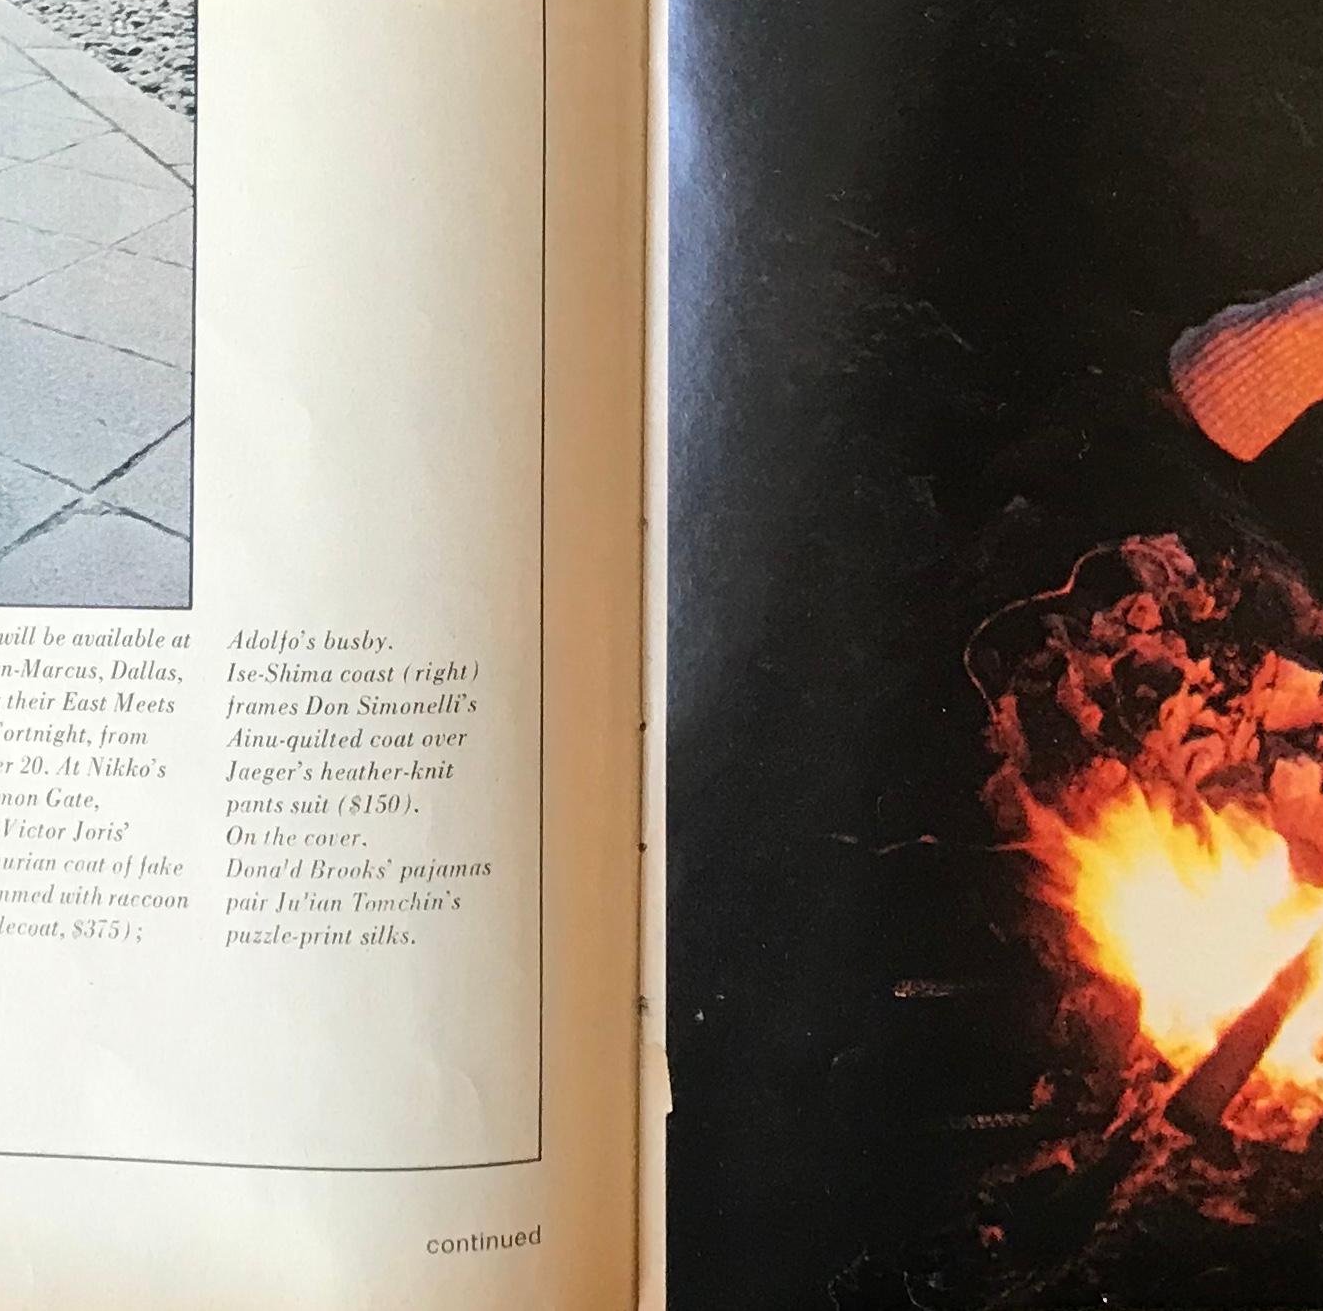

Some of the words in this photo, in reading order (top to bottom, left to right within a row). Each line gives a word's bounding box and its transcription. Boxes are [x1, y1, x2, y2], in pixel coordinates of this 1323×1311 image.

[42, 625, 66, 647] be
[71, 626, 166, 649] available
[171, 633, 191, 649] at
[226, 628, 316, 655] Adolfo's
[323, 628, 393, 655] busby.
[109, 659, 183, 685] Dallas,
[226, 661, 333, 684] Ise-Shima
[340, 666, 395, 684] coast
[403, 659, 479, 686] (right)
[6, 689, 57, 711] their
[61, 691, 108, 713] East
[113, 691, 175, 714] Meets
[225, 694, 299, 720] frames
[304, 694, 350, 716] Don
[356, 692, 477, 716] Simonelli's
[98, 724, 147, 750] from
[225, 727, 364, 754] Ainu-quilted
[369, 732, 415, 748] coat
[421, 732, 468, 748] over
[19, 755, 49, 776] 20.
[55, 755, 80, 777] At
[86, 756, 167, 779] Nikko's
[225, 759, 313, 786] Jaeger's
[320, 759, 455, 782] heather-knit
[45, 787, 100, 812] Gate,
[225, 797, 284, 818] pants
[289, 794, 329, 815] suit
[337, 793, 419, 817] ($150).
[3, 817, 67, 841] Victor
[72, 820, 130, 843] Joris'
[225, 824, 256, 846] On
[263, 825, 297, 847] the
[304, 833, 367, 847] cover.
[63, 857, 106, 874] coat
[111, 854, 134, 879] of
[137, 854, 184, 880] fake
[310, 857, 393, 880] Brooks'
[399, 858, 492, 885] pajamas
[59, 885, 102, 907] with
[108, 893, 190, 909] raccoon
[225, 891, 269, 916] pair
[352, 889, 461, 913] Tomchin's
[71, 918, 143, 944] $375);
[224, 923, 352, 950] puzzle-print
[359, 924, 416, 946] silks.
[426, 1224, 542, 1255] continued
